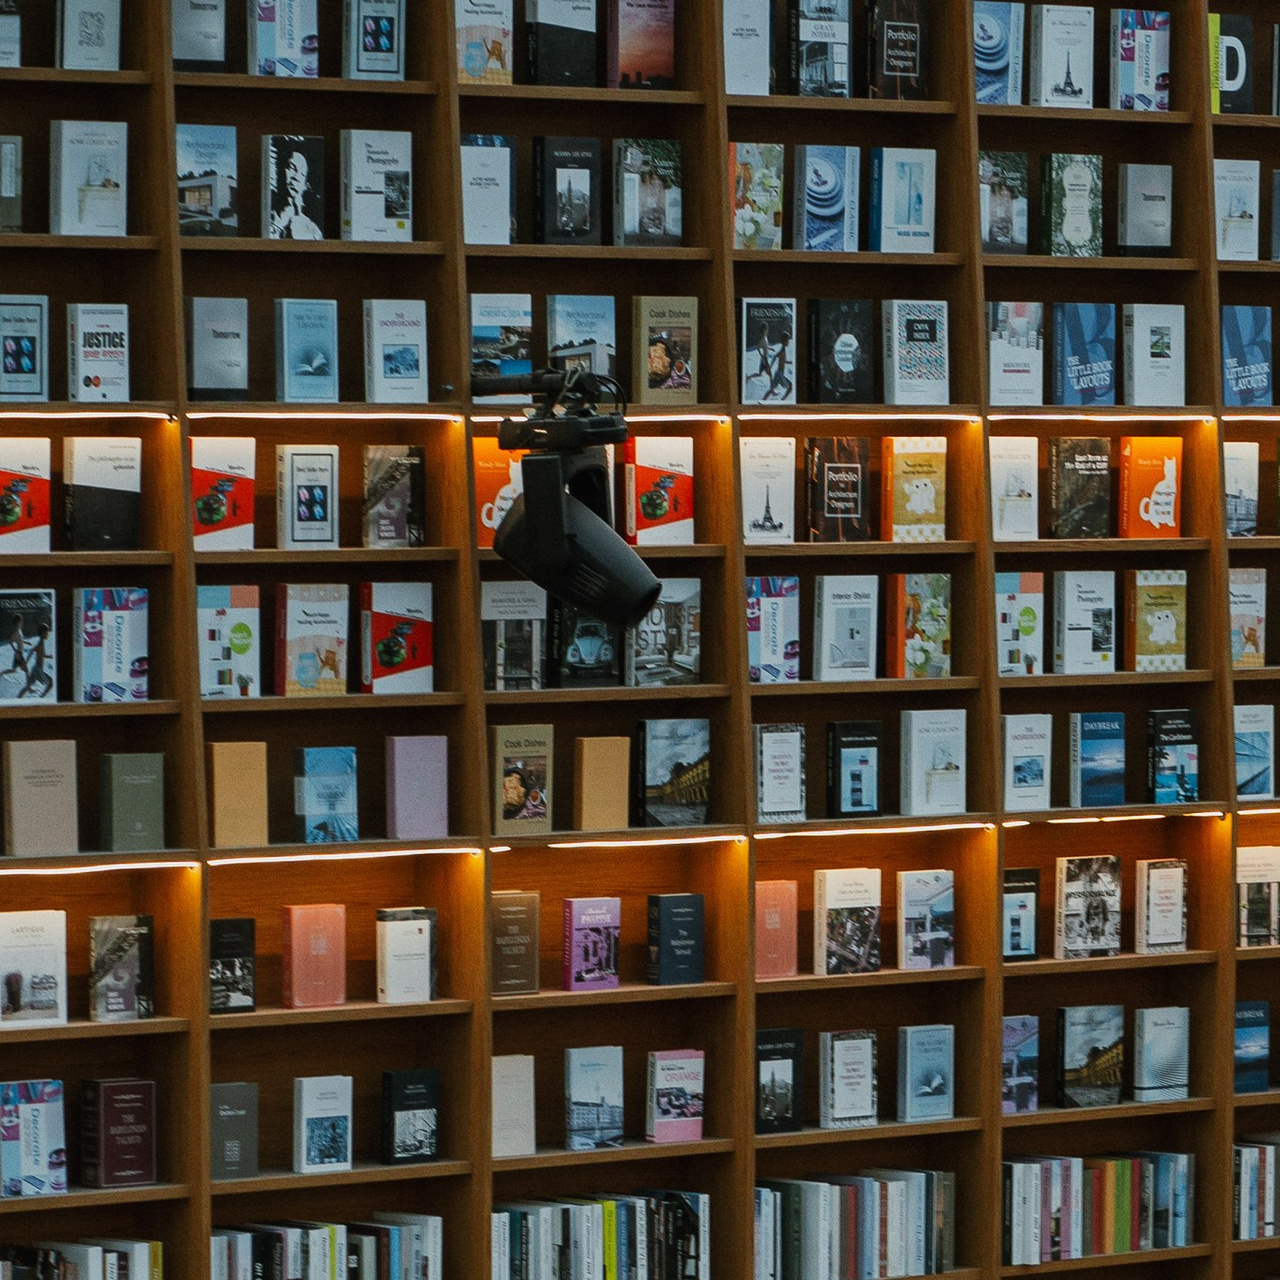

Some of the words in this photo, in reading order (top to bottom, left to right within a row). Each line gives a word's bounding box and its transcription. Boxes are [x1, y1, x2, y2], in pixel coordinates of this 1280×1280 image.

[886, 29, 917, 42] Portfolio
[1142, 35, 1152, 87] Decorate
[1221, 36, 1247, 92] D
[649, 309, 669, 319] Cook
[670, 309, 691, 319] Dishes
[82, 332, 125, 348] JUSTICE
[212, 329, 241, 341] Tomorrow
[1068, 356, 1080, 367] THE
[1226, 357, 1238, 367] THE
[1068, 364, 1093, 379] LITTLE
[1093, 361, 1113, 374] BOOK
[1226, 365, 1251, 380] LITTLE
[1251, 362, 1270, 376] BOOK
[1074, 373, 1110, 389] LAYOUTS
[1232, 374, 1268, 390] LAYOUTS
[828, 471, 858, 482] Portfolio
[832, 591, 853, 600] Interior
[770, 601, 779, 655] Decorate
[114, 615, 123, 673] Decorate
[1084, 720, 1120, 731] DAYBREAK
[505, 738, 523, 748] Cook
[525, 737, 547, 748] Dishes
[665, 1072, 701, 1082] ORANGE
[33, 1107, 42, 1167] Decorate
